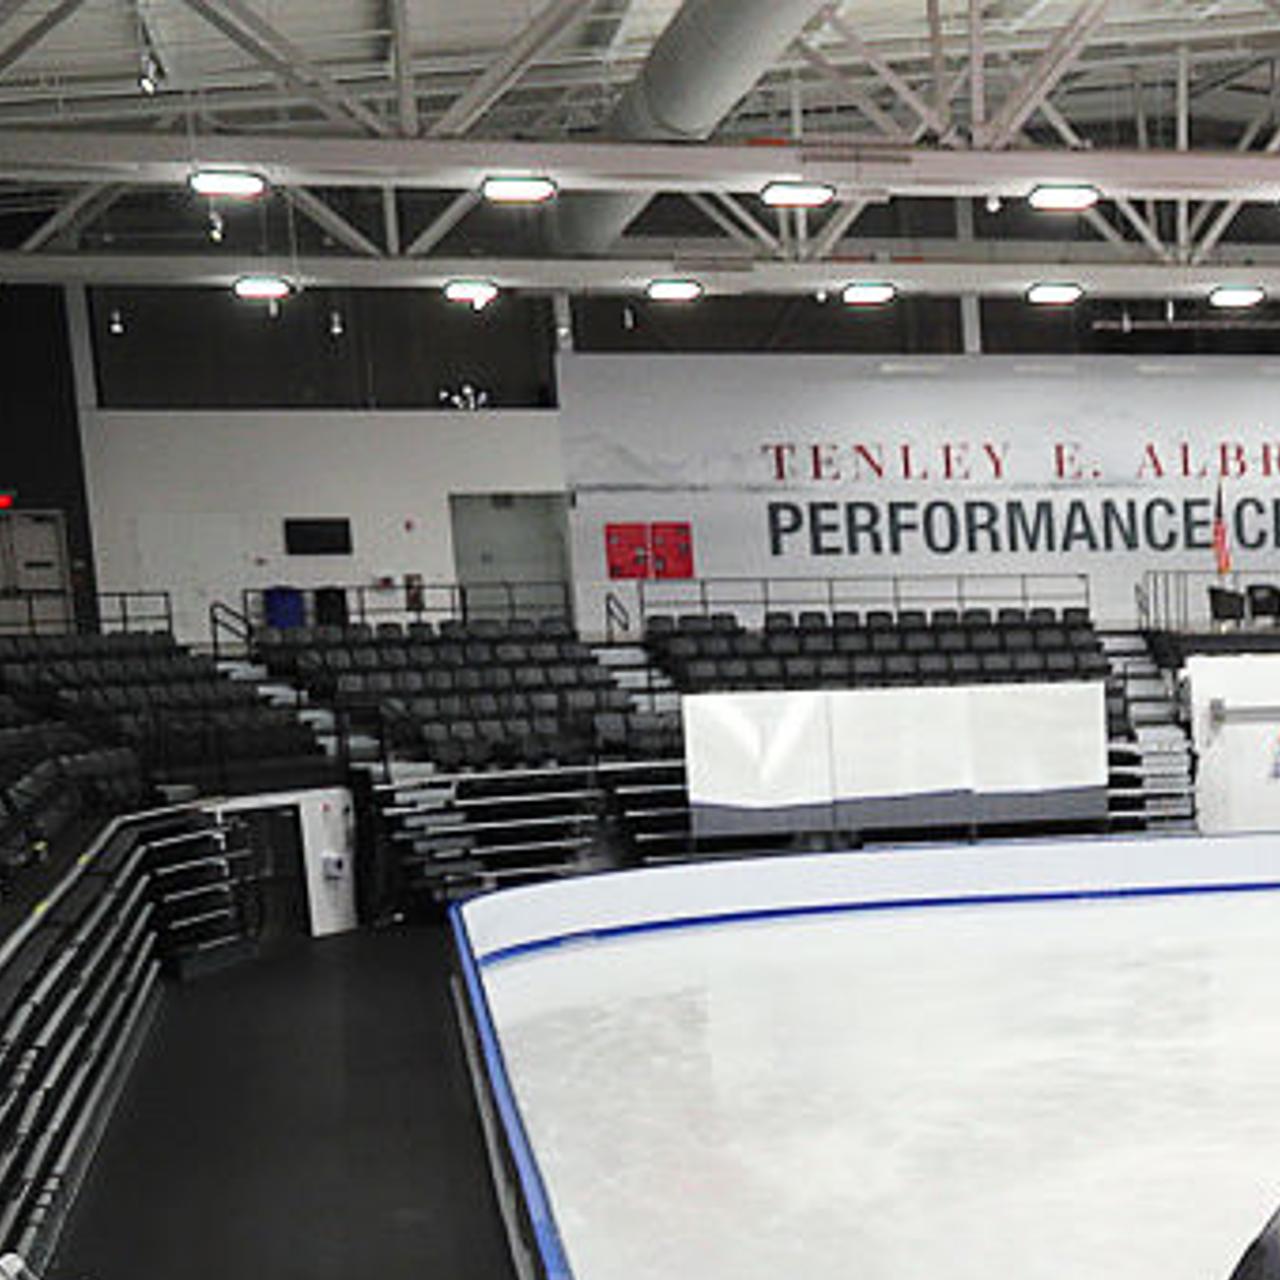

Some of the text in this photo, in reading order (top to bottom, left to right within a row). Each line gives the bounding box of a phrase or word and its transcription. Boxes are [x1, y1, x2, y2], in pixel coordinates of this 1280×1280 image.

[761, 443, 1010, 481] TENLEY
[1054, 443, 1101, 479] E.
[767, 498, 1215, 556] PERFORMANCE
